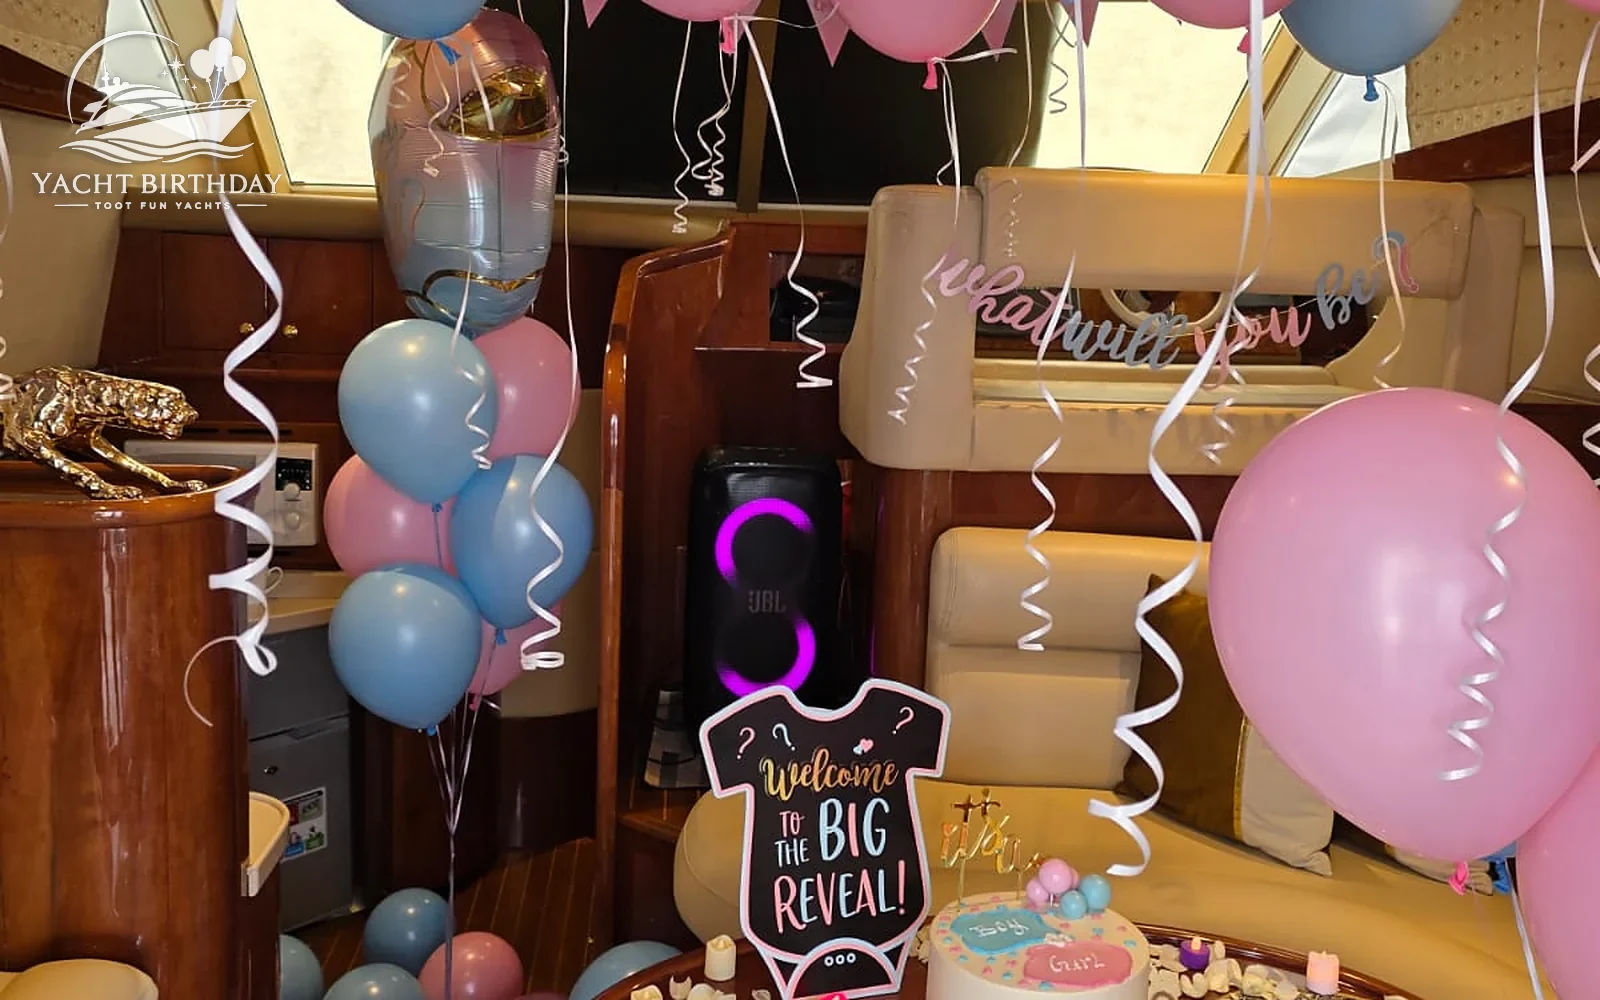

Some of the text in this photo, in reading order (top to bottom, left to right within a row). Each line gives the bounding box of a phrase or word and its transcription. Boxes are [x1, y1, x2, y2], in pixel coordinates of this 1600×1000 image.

[1063, 310, 1189, 370] will
[1195, 305, 1312, 390] you
[748, 589, 787, 613] JBL
[759, 746, 899, 801] Welcome
[774, 797, 890, 867] THE BIG
[779, 810, 805, 838] TO
[773, 860, 906, 934] REVEAL!
